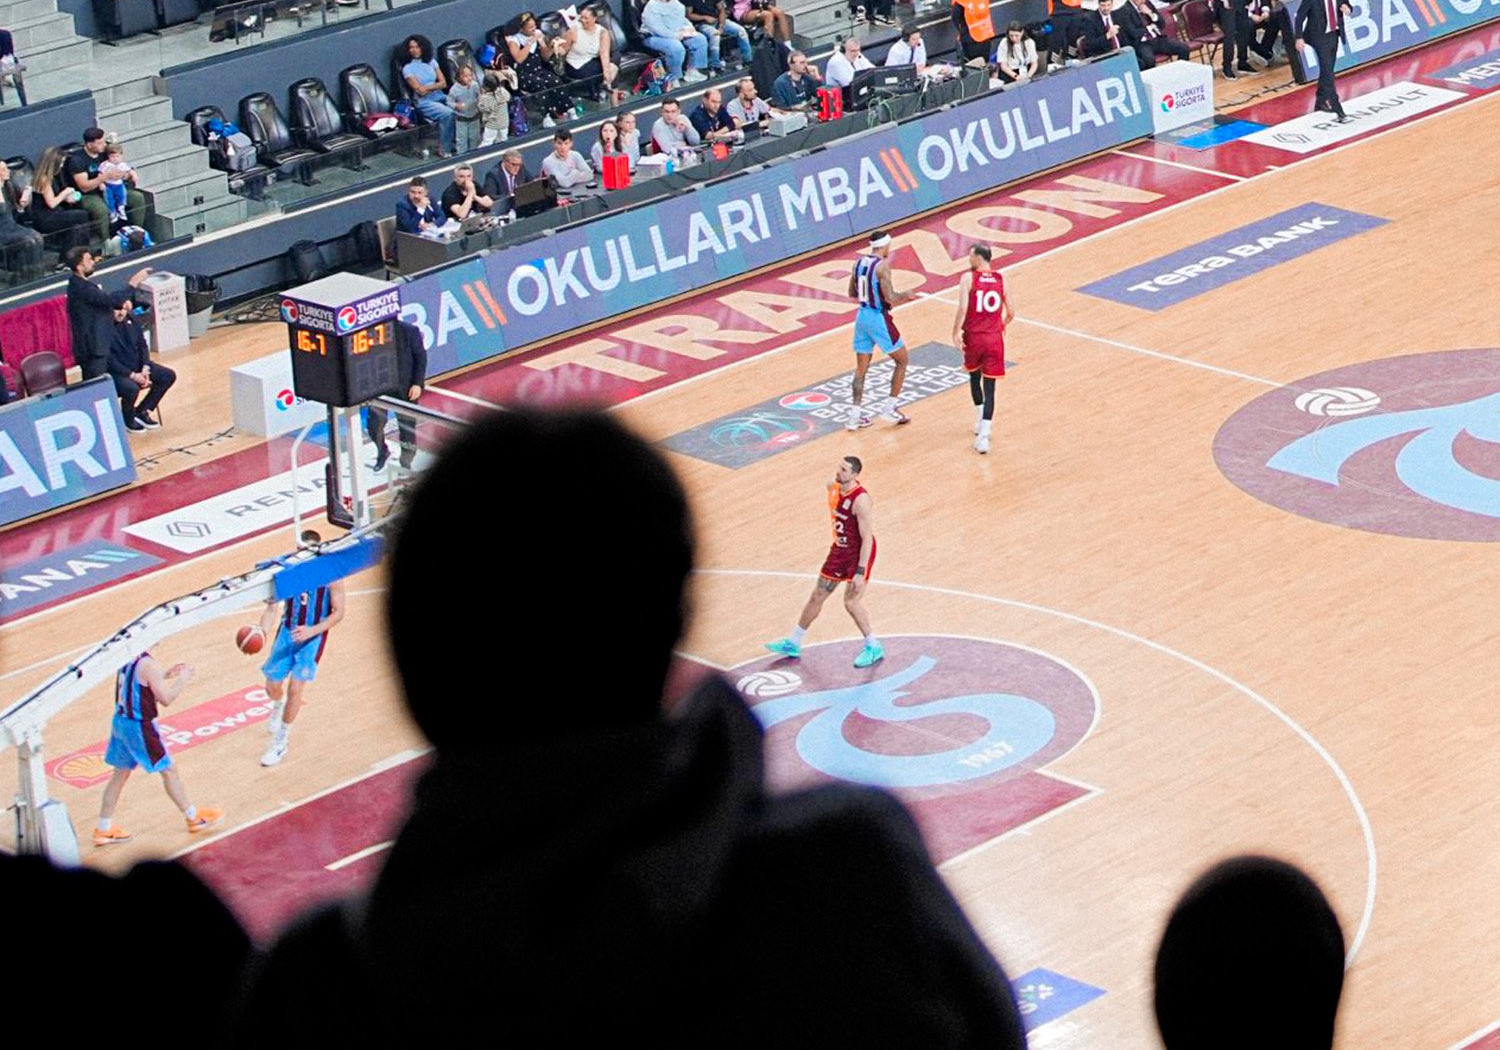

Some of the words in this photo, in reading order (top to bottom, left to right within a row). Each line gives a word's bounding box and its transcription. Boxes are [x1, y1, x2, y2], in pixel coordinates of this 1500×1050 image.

[917, 71, 1142, 181] OKULLARI
[778, 156, 894, 231] MBA
[507, 193, 772, 316] OKULLARI
[1227, 216, 1340, 258] BANK
[521, 175, 1165, 382] TRABZON
[976, 290, 1001, 313] 10
[0, 556, 110, 602] ANA
[957, 741, 1014, 768] 1967
